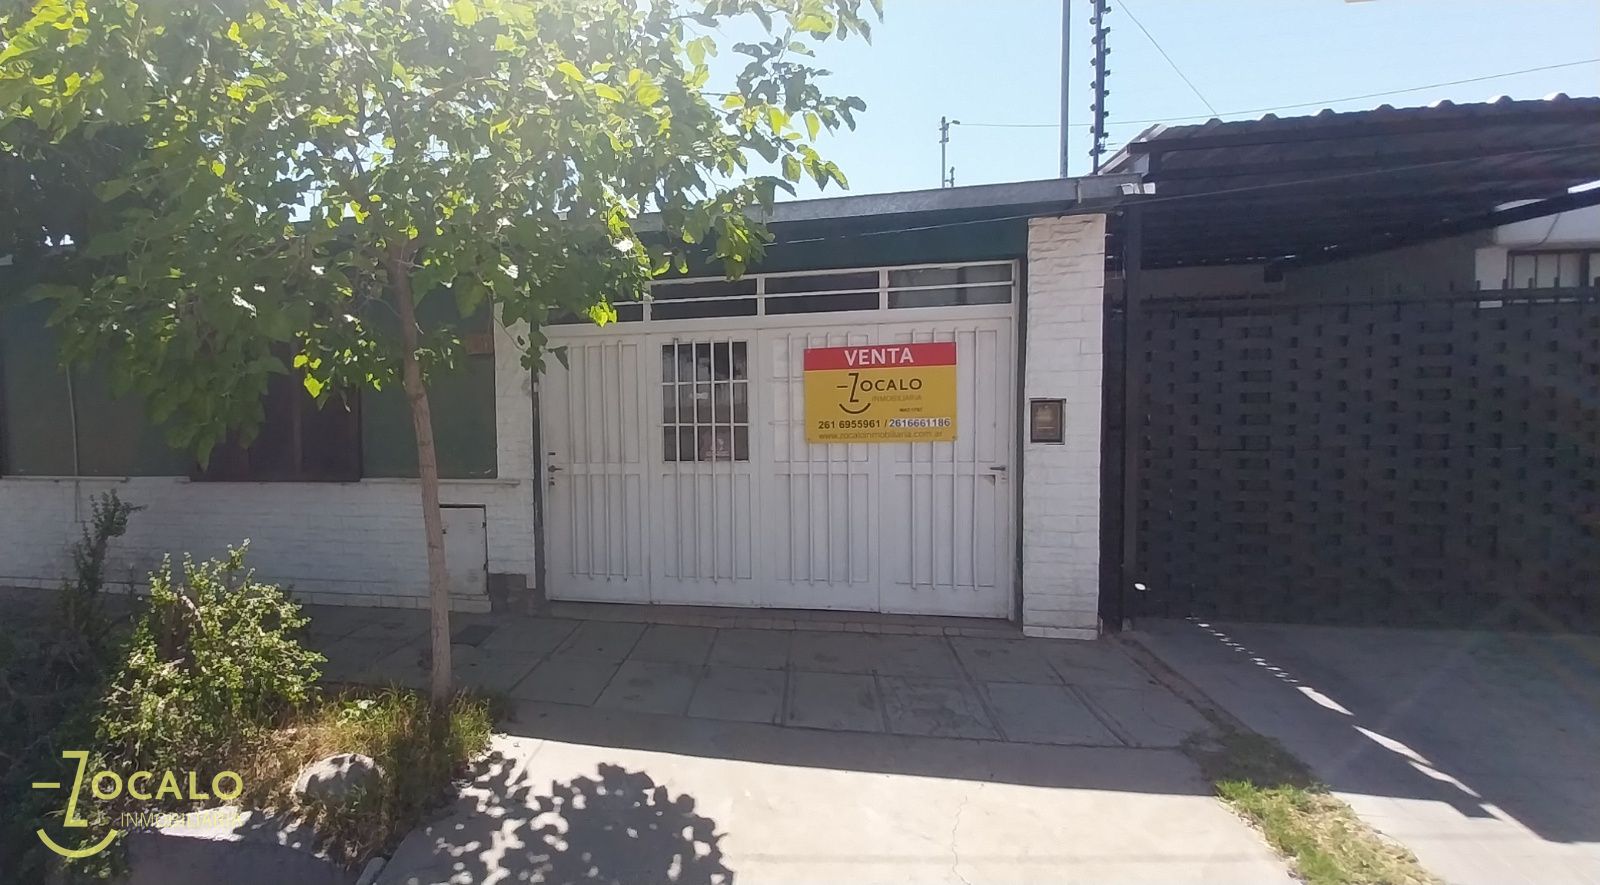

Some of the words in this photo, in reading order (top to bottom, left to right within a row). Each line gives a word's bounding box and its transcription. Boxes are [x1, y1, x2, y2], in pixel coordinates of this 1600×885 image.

[844, 347, 914, 366] VENTA
[848, 372, 923, 403] ZOCALO
[818, 420, 836, 430] 261
[838, 419, 881, 429] 6955961
[889, 417, 951, 428] 2616661186
